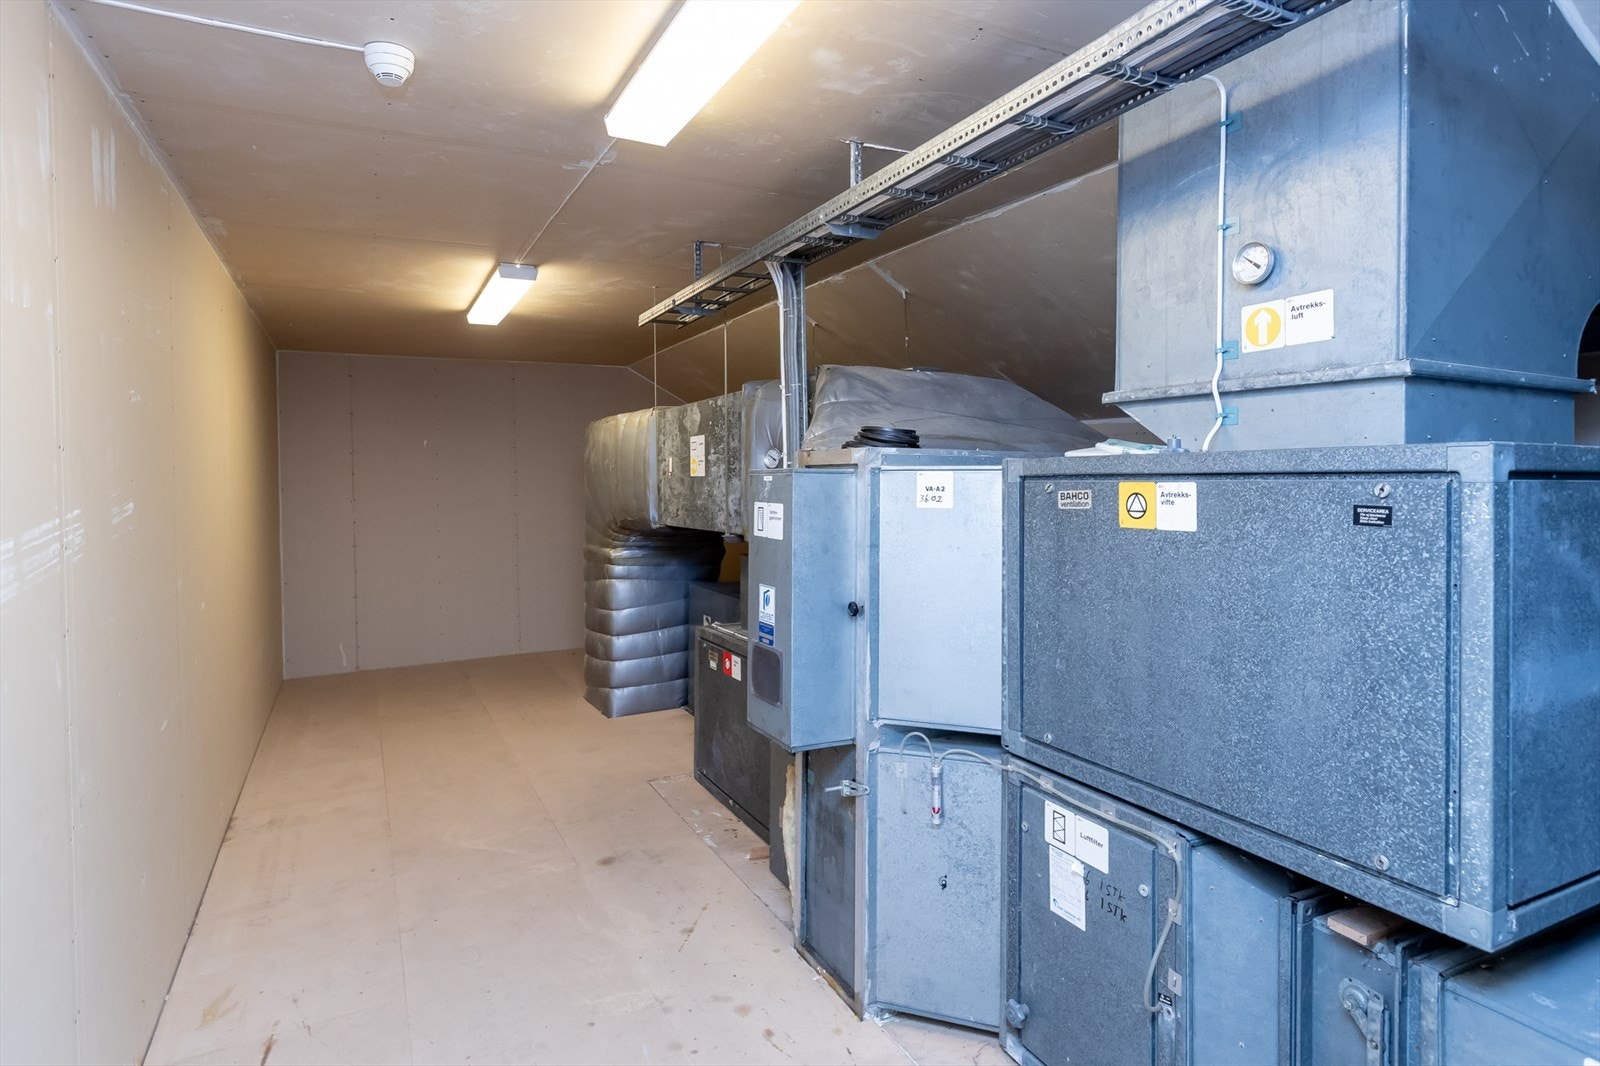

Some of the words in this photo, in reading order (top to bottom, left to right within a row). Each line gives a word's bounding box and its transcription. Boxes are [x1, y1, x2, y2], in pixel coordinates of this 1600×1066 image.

[1290, 301, 1326, 312] Avtrekks-
[1291, 312, 1304, 320] luft
[1060, 491, 1089, 501] BAHCO
[1160, 491, 1192, 499] Avtrekks-
[1080, 832, 1104, 849] Luftfilter
